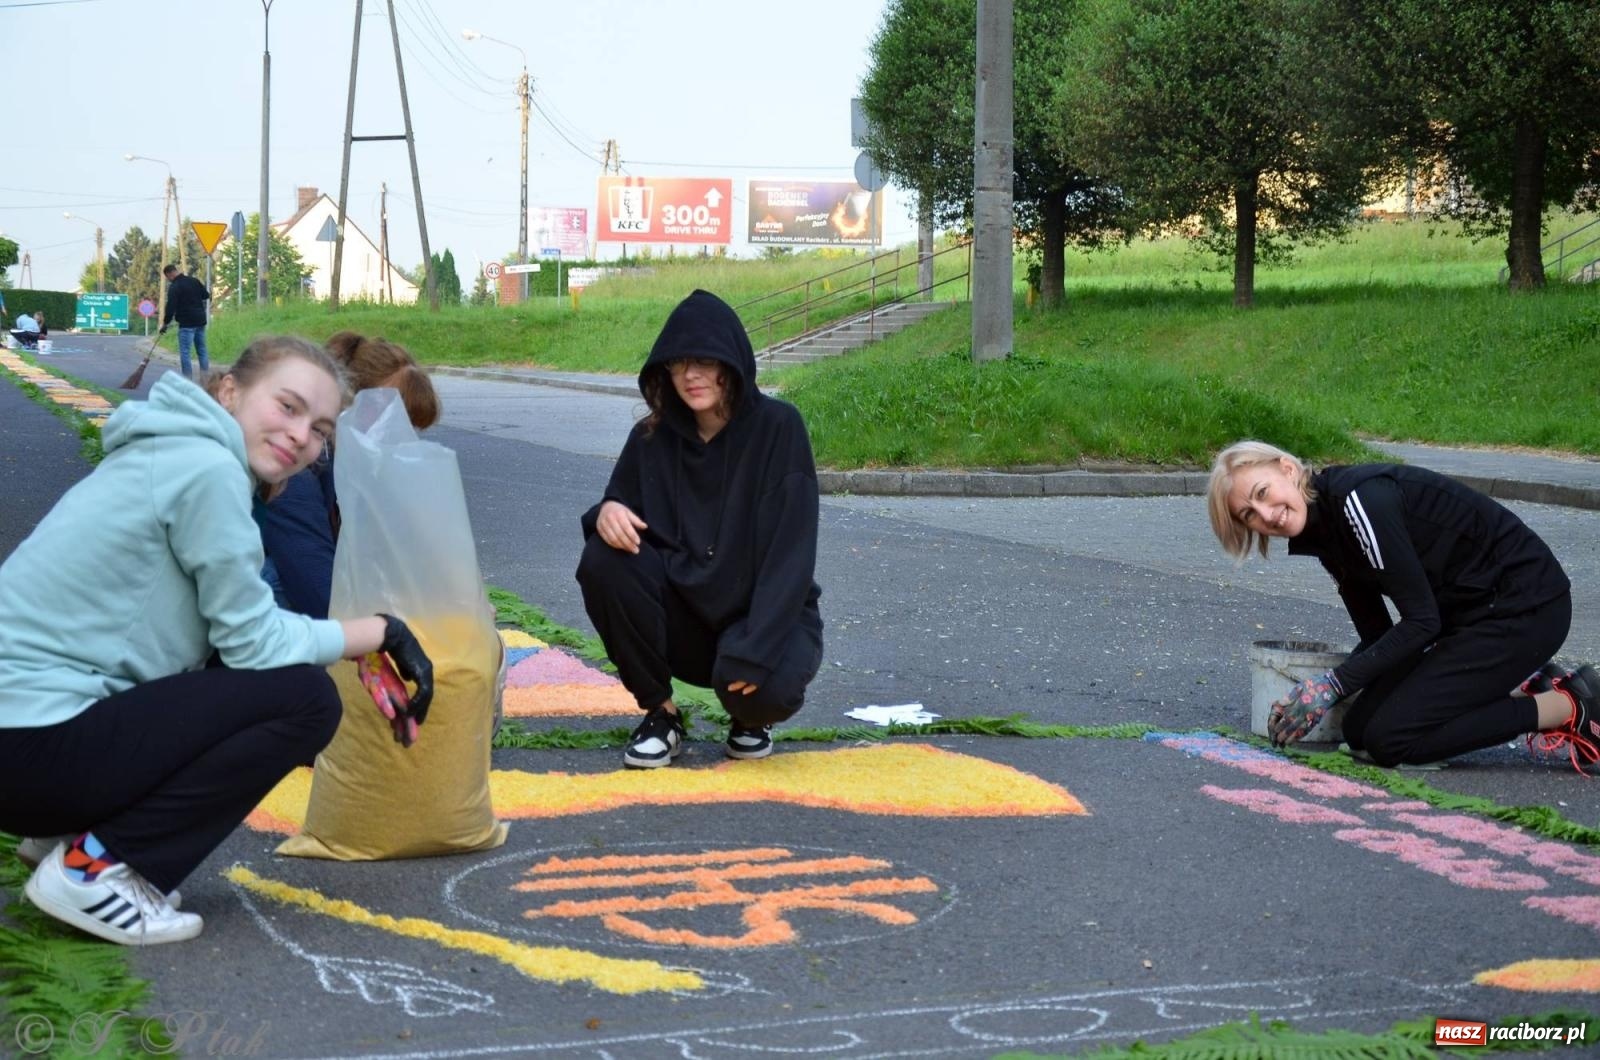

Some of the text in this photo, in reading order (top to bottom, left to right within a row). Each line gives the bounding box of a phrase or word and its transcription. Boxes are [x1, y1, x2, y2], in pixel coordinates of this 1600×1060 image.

[618, 220, 643, 230] KFC
[664, 226, 717, 235] DRIVE THRU
